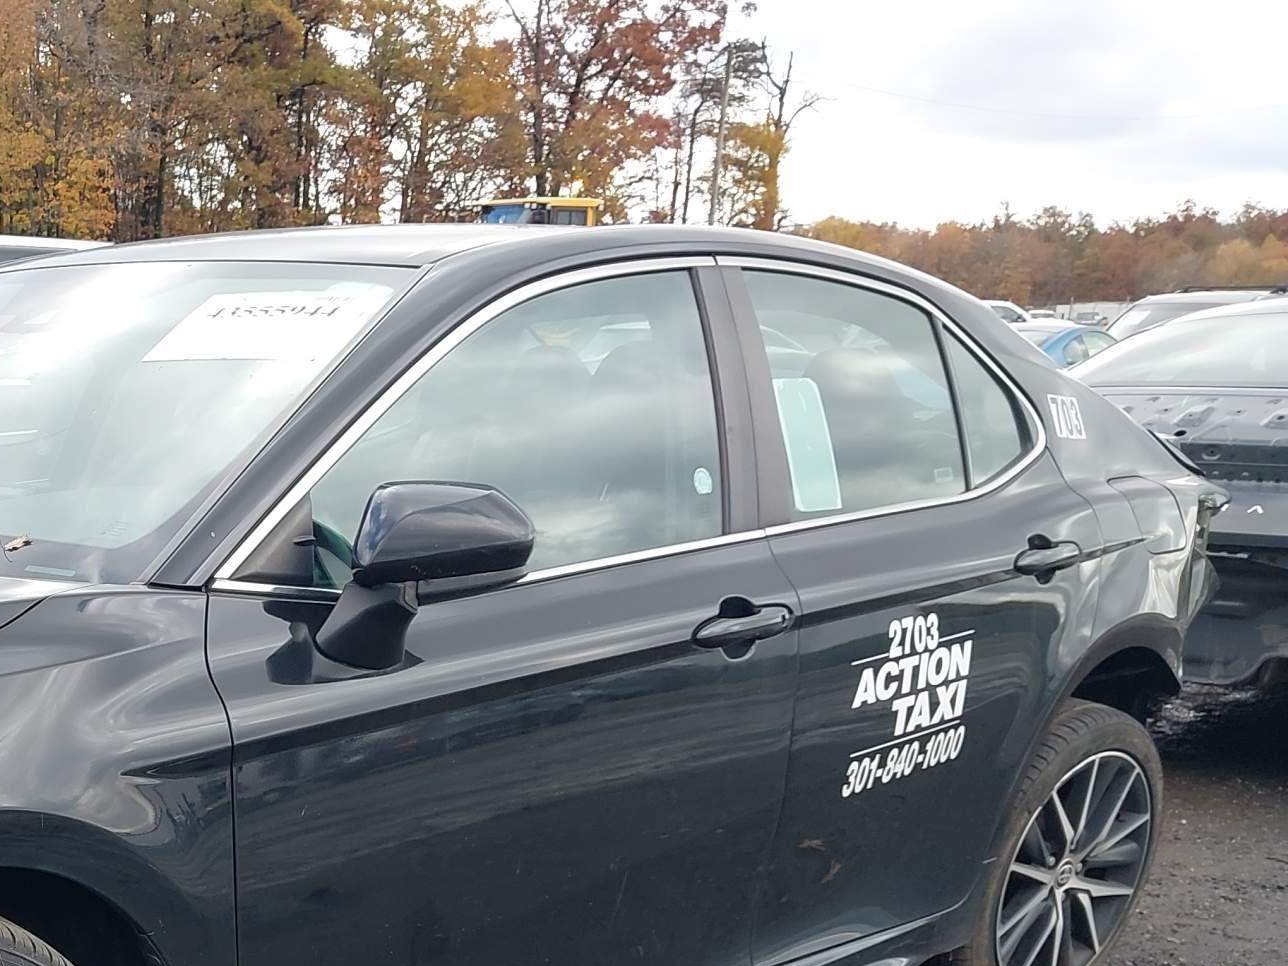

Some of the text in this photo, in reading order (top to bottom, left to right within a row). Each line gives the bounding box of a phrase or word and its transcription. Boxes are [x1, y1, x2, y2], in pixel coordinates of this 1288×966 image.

[888, 612, 940, 659] 2703
[850, 639, 974, 709] ACTION
[890, 678, 968, 737] TAXI
[841, 724, 966, 798] 301-840-1000
